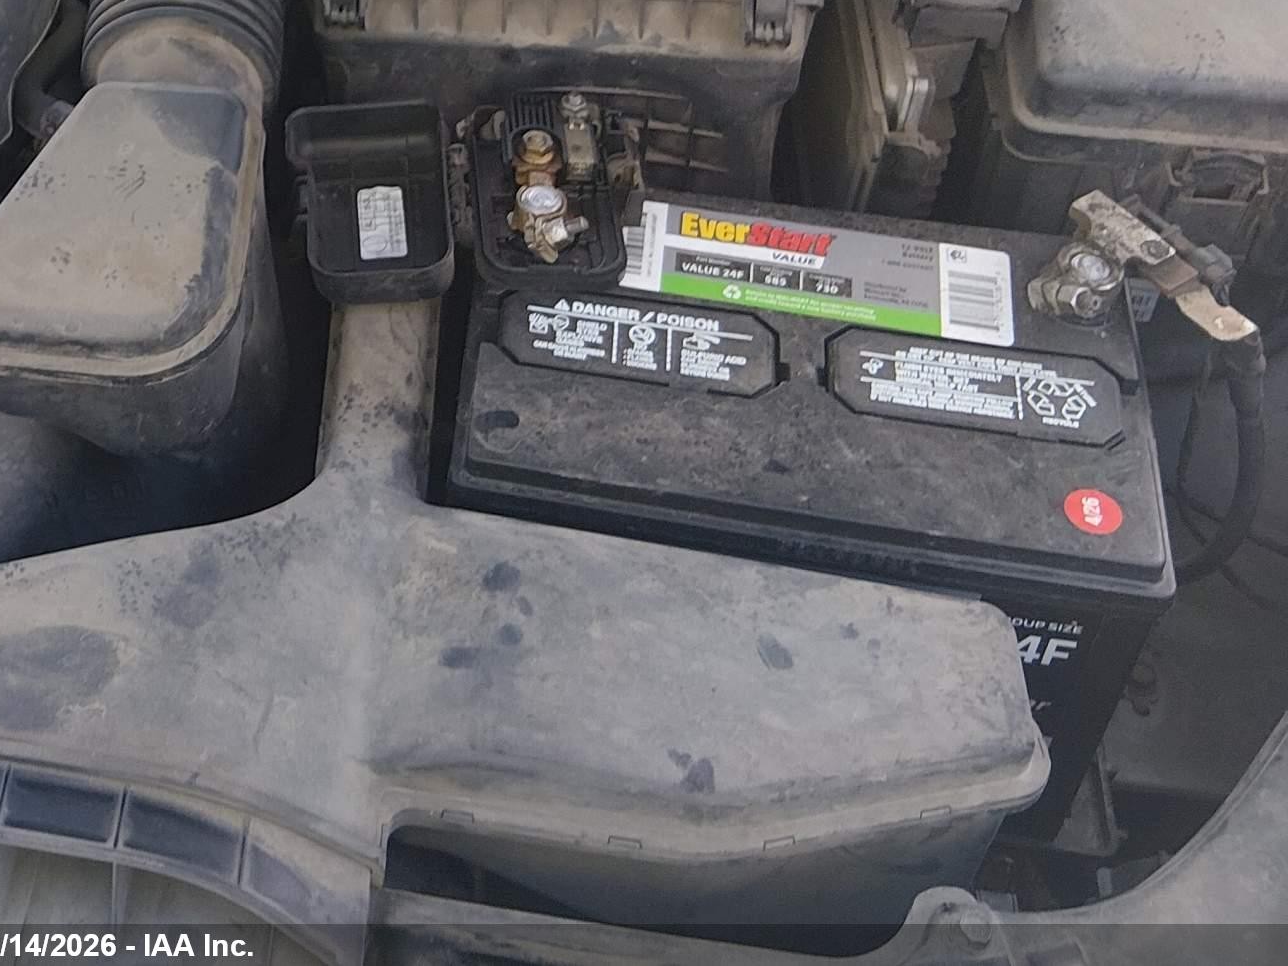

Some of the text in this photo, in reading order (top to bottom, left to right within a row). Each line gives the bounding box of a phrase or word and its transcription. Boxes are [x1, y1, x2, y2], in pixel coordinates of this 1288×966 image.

[680, 211, 833, 257] EverStart
[772, 251, 818, 266] VALUE
[681, 262, 719, 276] VALUE
[722, 268, 745, 280] 24F
[571, 301, 640, 322] DANGER
[655, 312, 720, 332] POISON
[1047, 621, 1083, 635] SIZE
[1016, 634, 1078, 666] 4F
